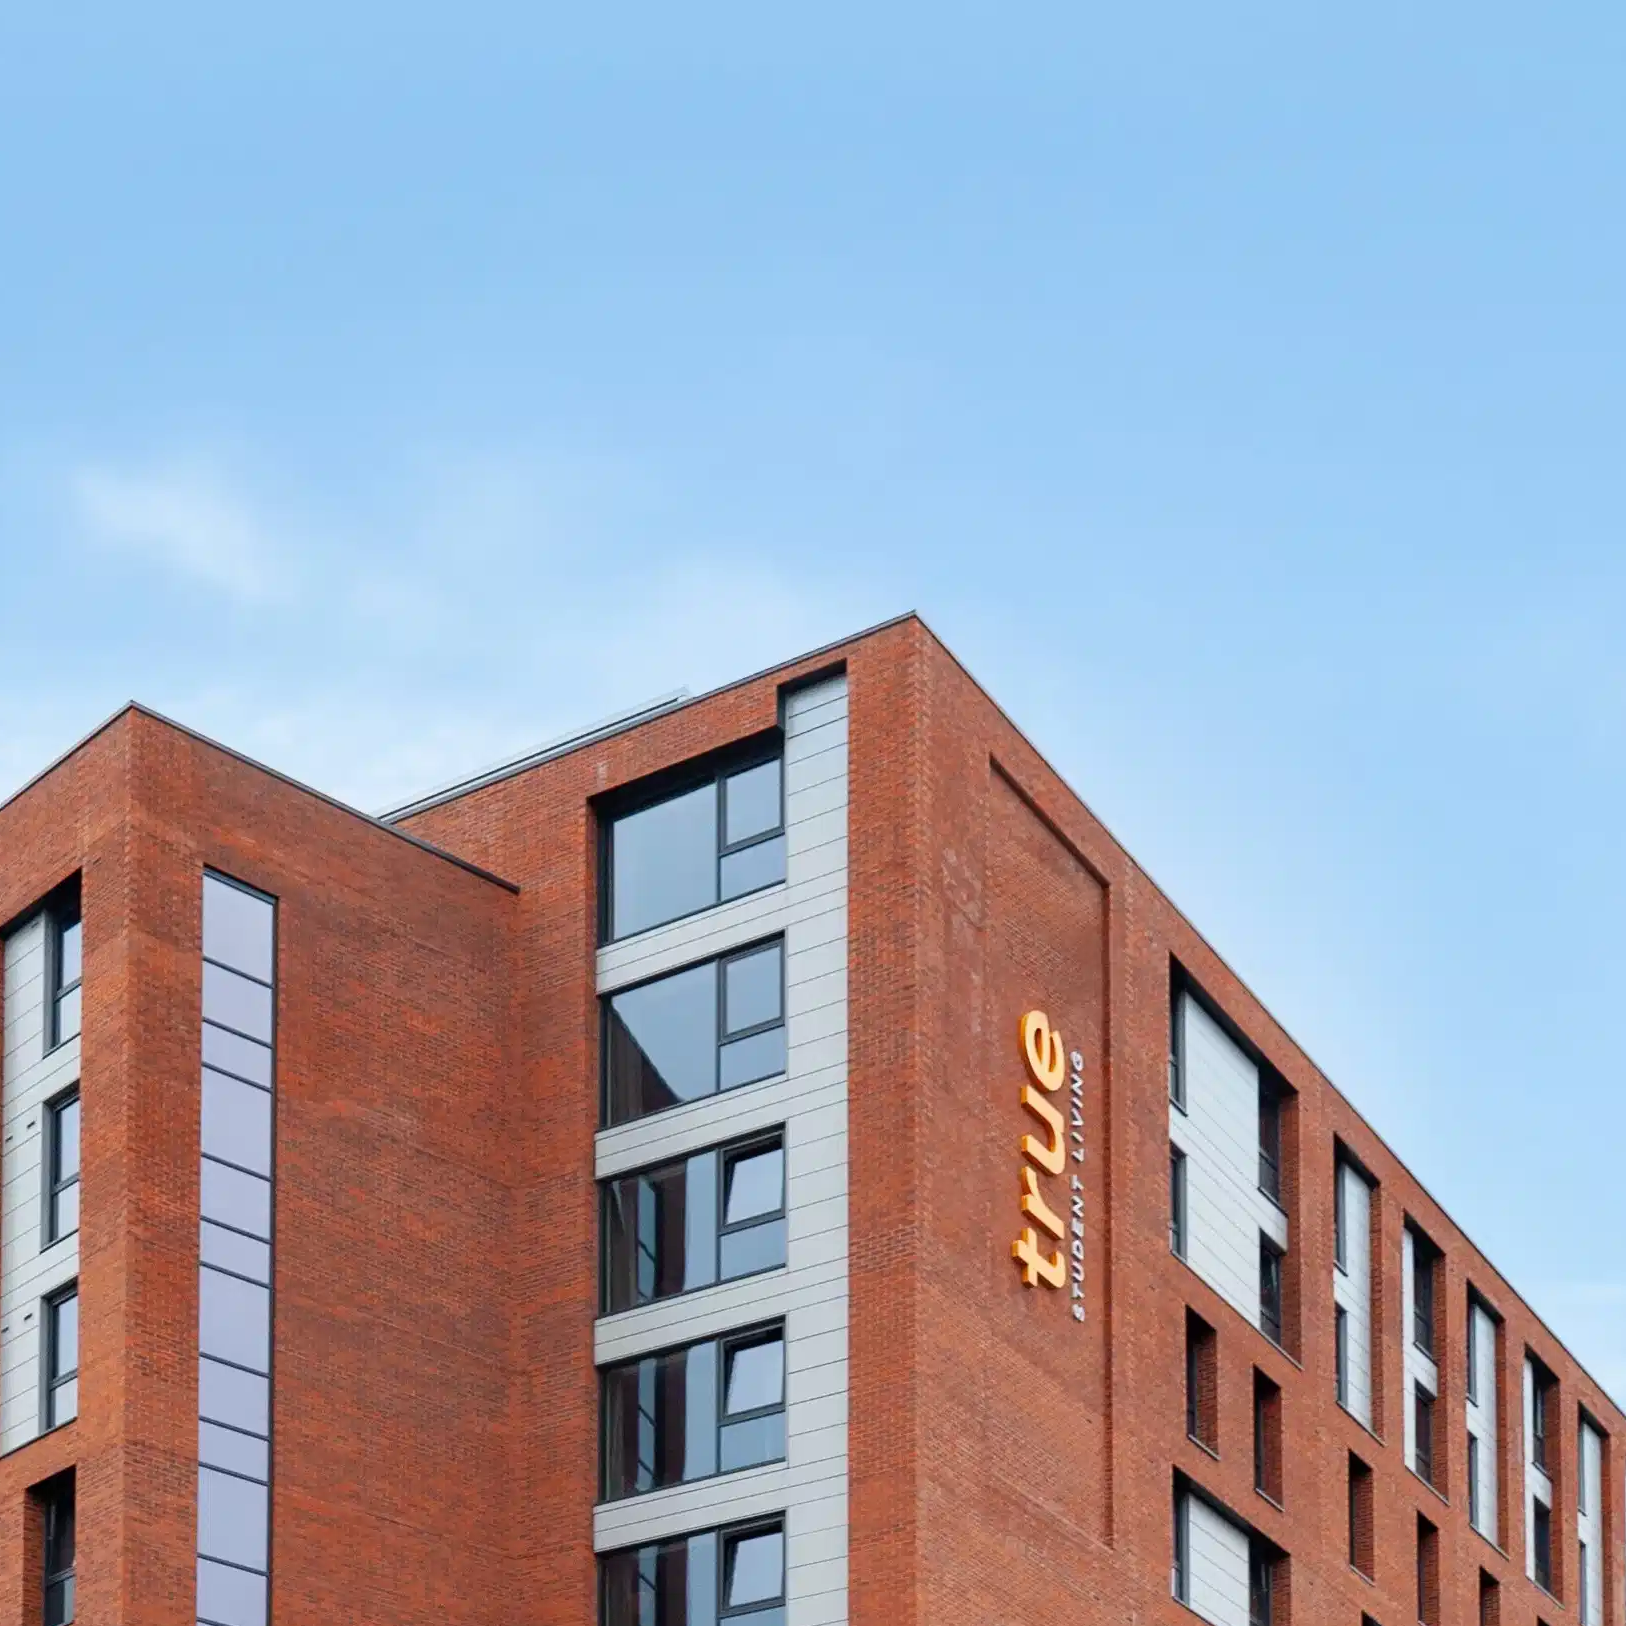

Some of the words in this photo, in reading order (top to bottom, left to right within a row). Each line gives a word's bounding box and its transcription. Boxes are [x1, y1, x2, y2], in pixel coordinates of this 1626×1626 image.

[1011, 1009, 1066, 1291] true
[1070, 1051, 1085, 1164] LIVING
[1070, 1175, 1086, 1322] STUDENT
